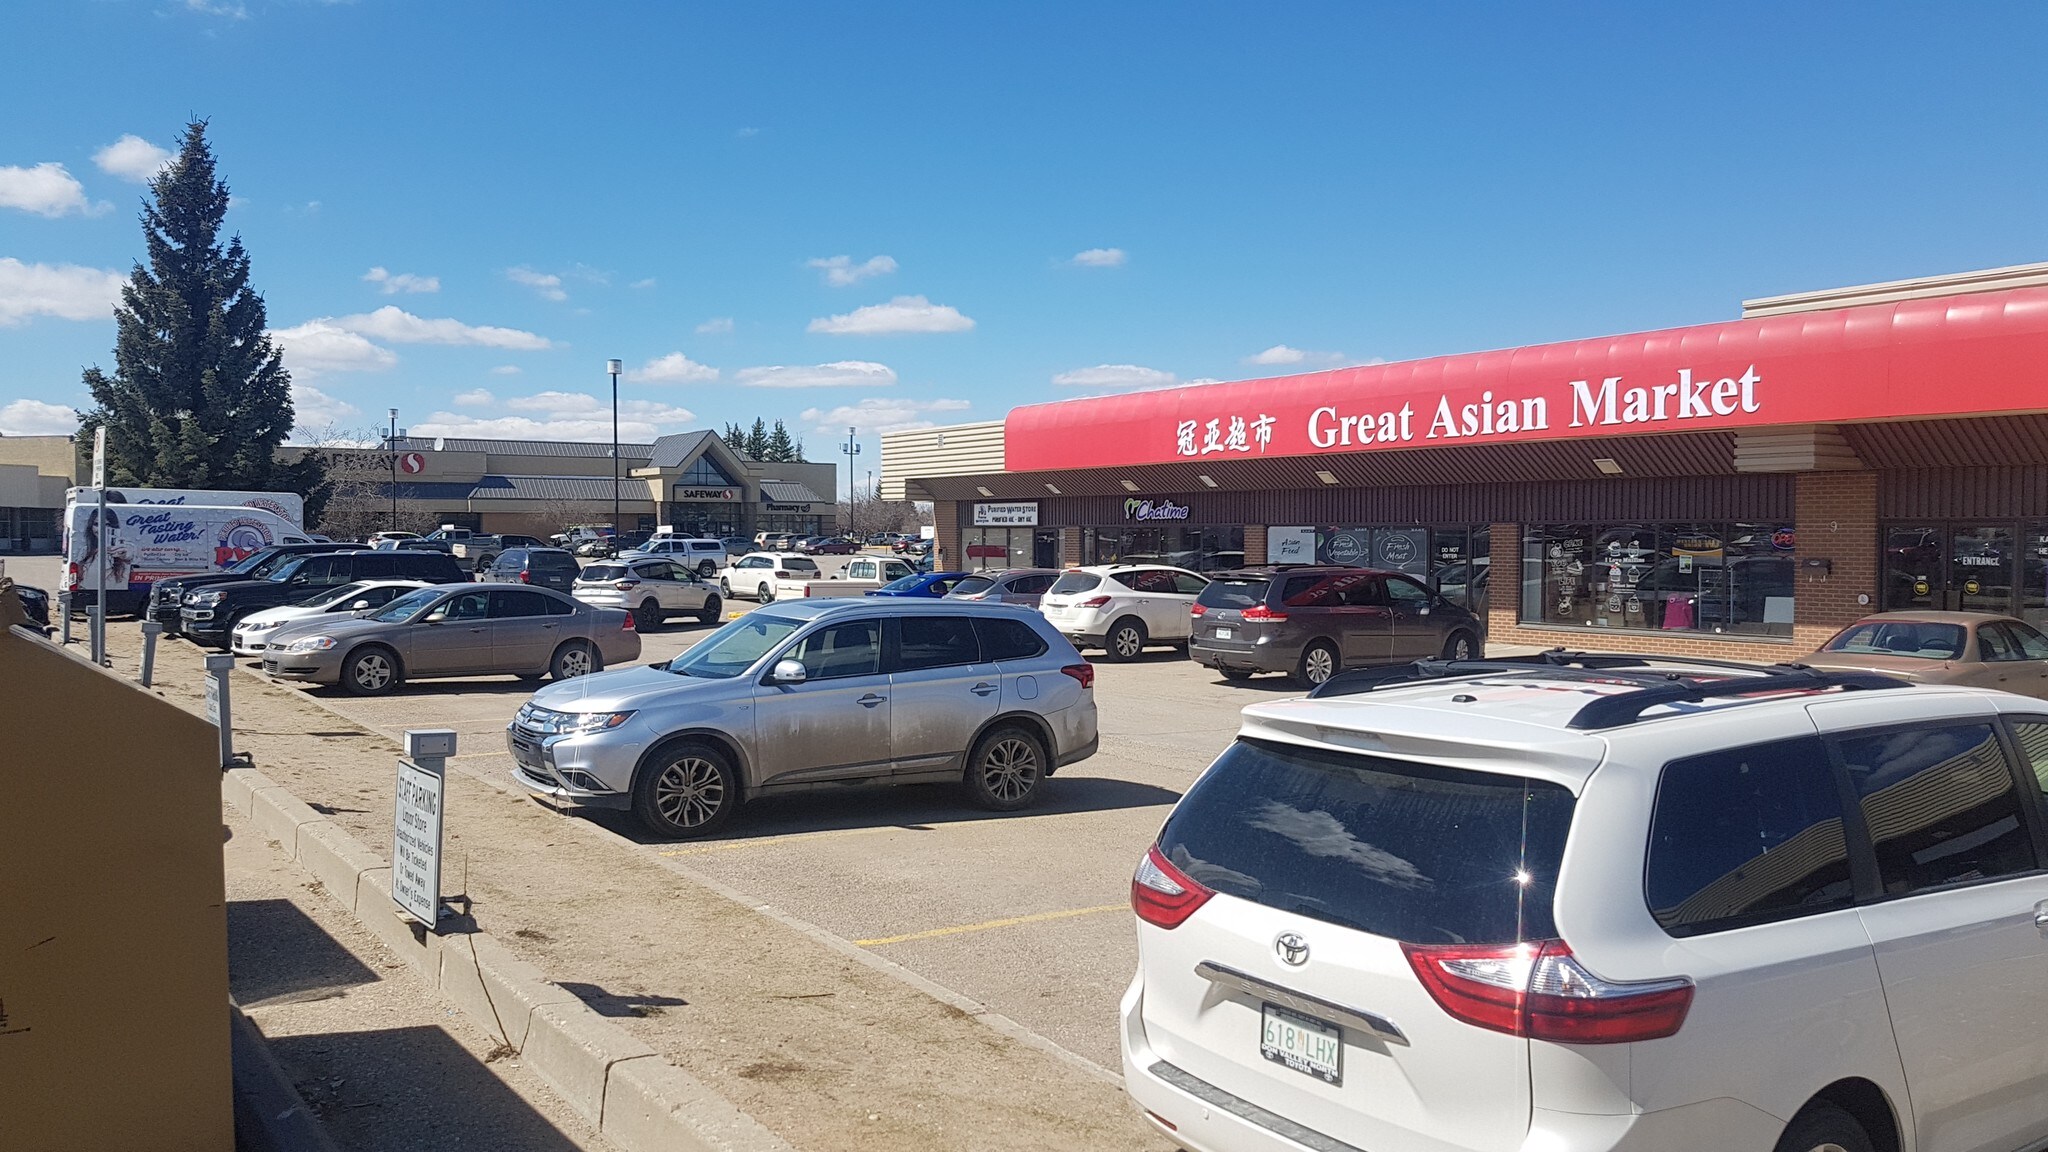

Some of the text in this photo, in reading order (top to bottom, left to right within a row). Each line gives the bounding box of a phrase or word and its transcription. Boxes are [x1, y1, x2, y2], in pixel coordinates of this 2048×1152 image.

[1307, 364, 1761, 448] Great Asian Market
[684, 490, 722, 499] SAFEWAY
[766, 503, 800, 513] Pharmacy
[1136, 500, 1189, 520] Chatime
[126, 511, 172, 526] Great
[139, 519, 196, 536] Tasting
[1830, 521, 1838, 532] 9
[153, 529, 206, 545] Water!
[1386, 541, 1410, 551] Fresh
[1386, 552, 1408, 560] Meat
[1962, 556, 2000, 566] ENTRANCE
[399, 776, 437, 816] STAFF PARKING
[414, 813, 427, 834] Store
[417, 837, 434, 857] Vehicles
[411, 852, 427, 871] Ticketed
[404, 864, 415, 883] Towed
[415, 872, 426, 892] Away
[413, 888, 431, 910] Expense
[1266, 1020, 1336, 1067] 618 LHX
[1262, 1043, 1338, 1078] DON VALLEY NORTH
[1285, 1058, 1313, 1075] TOYOTA
